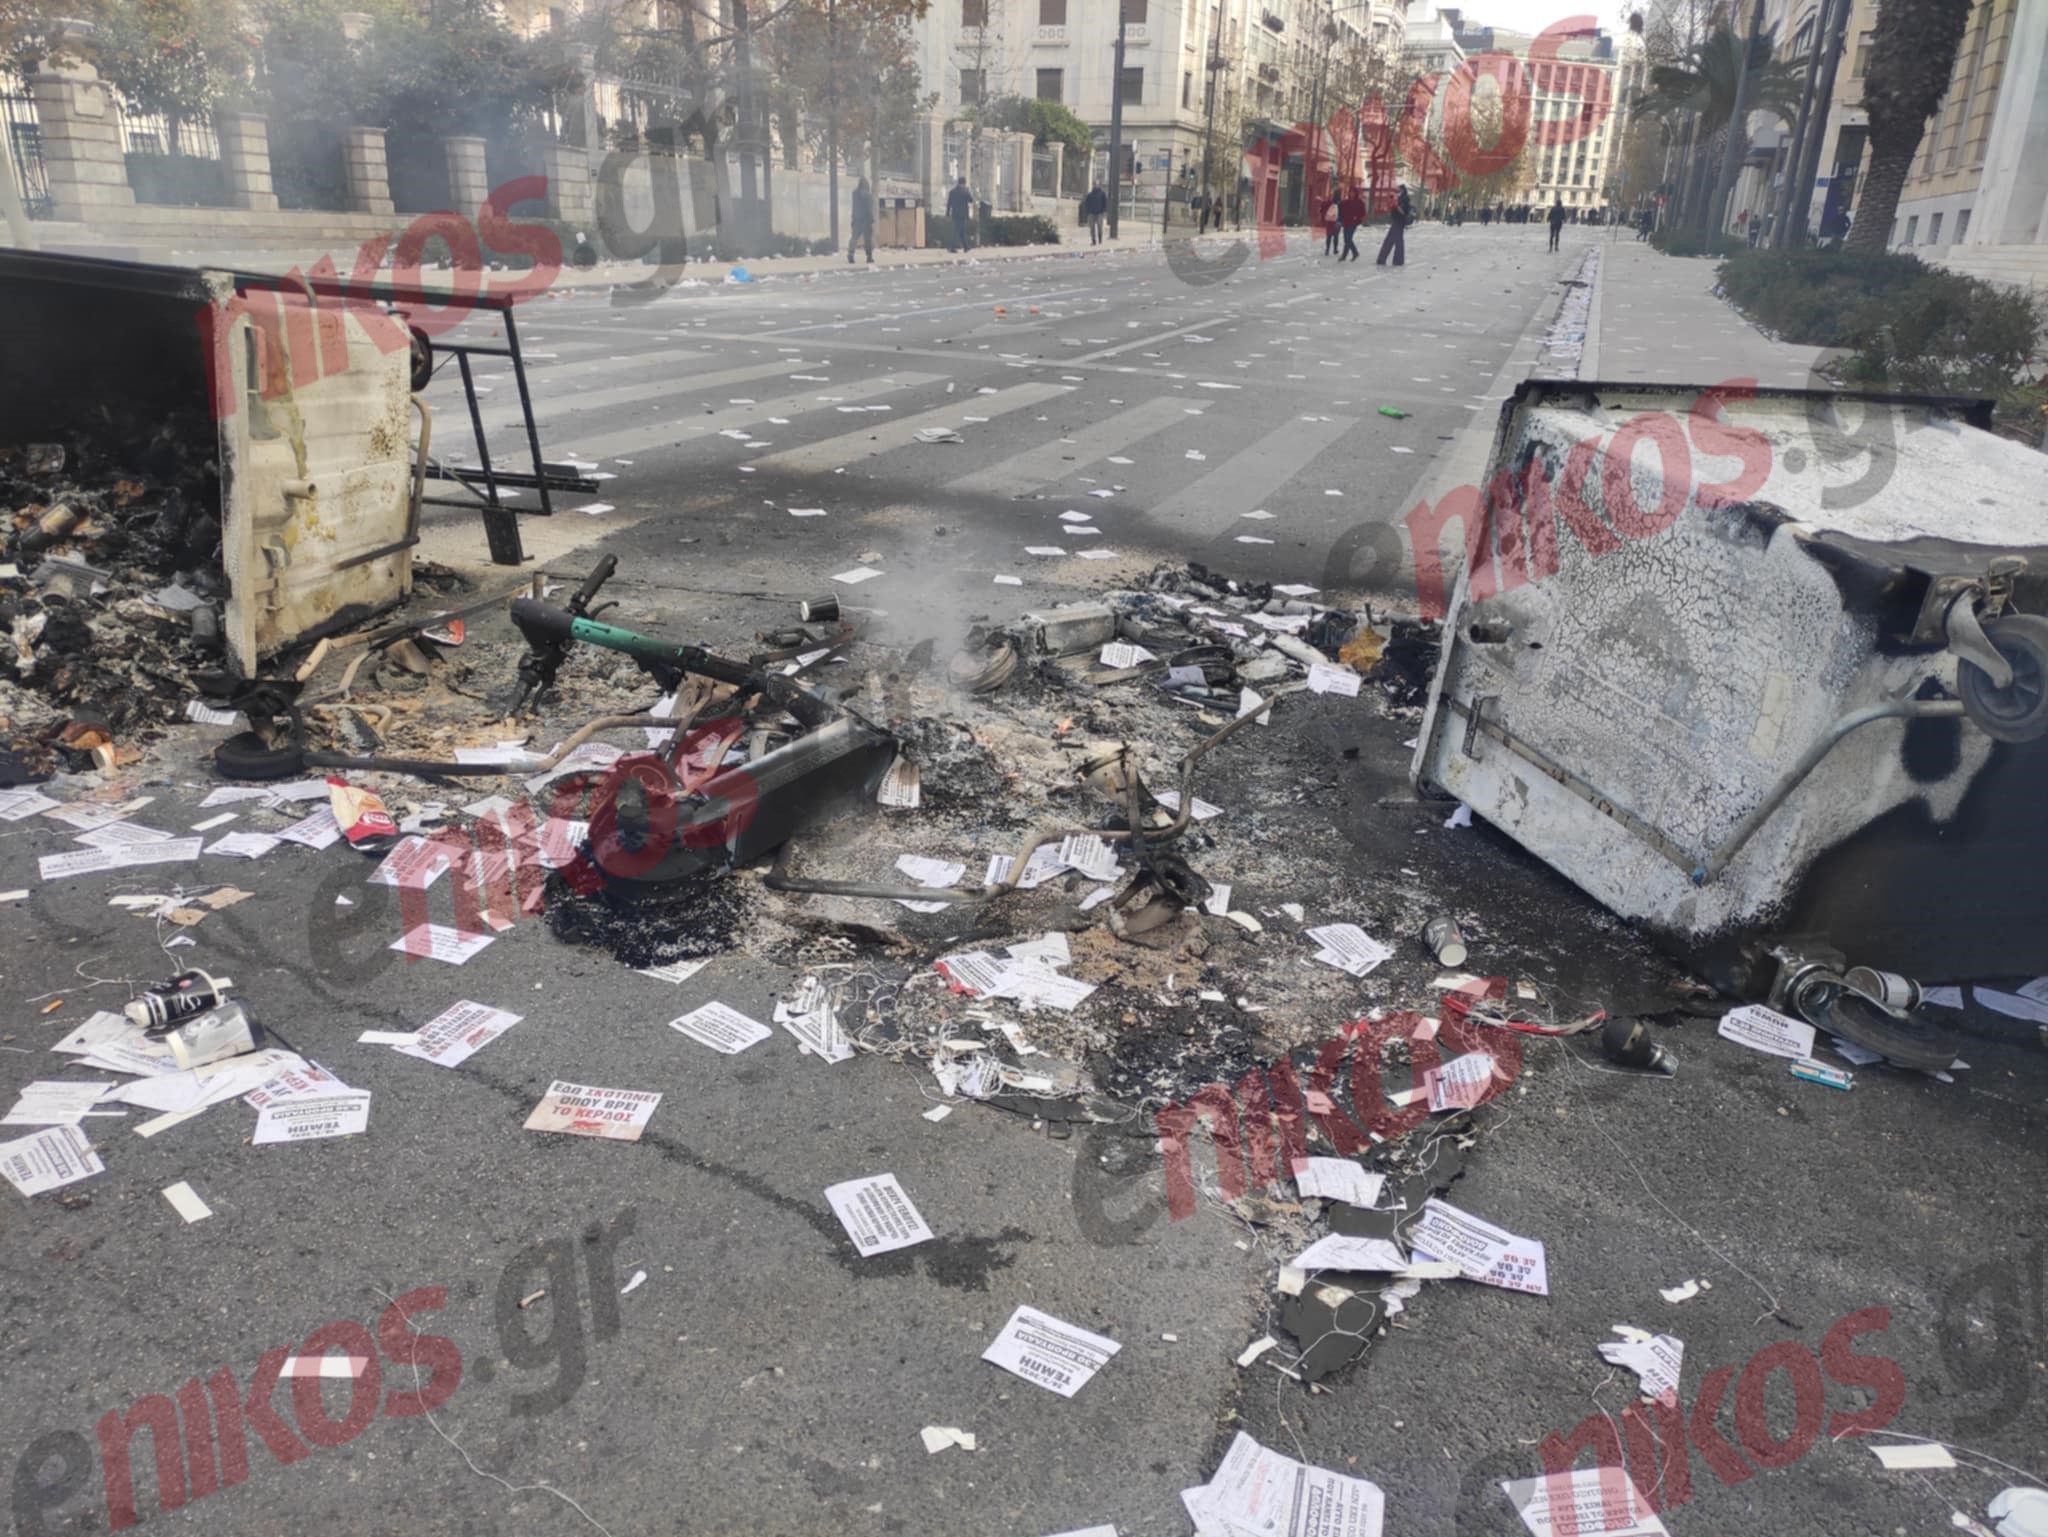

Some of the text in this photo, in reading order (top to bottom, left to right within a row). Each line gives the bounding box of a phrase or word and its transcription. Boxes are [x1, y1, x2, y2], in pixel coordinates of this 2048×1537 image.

[586, 1088, 657, 1103] ΣΚΟΤΩΝΕΙ
[560, 1096, 639, 1112] ΟΠΟΥ ΒΡΕΙ
[575, 1108, 635, 1122] ΚΕΡΔΟΣ
[1018, 1355, 1071, 1385] ΤΕΜΠΗ
